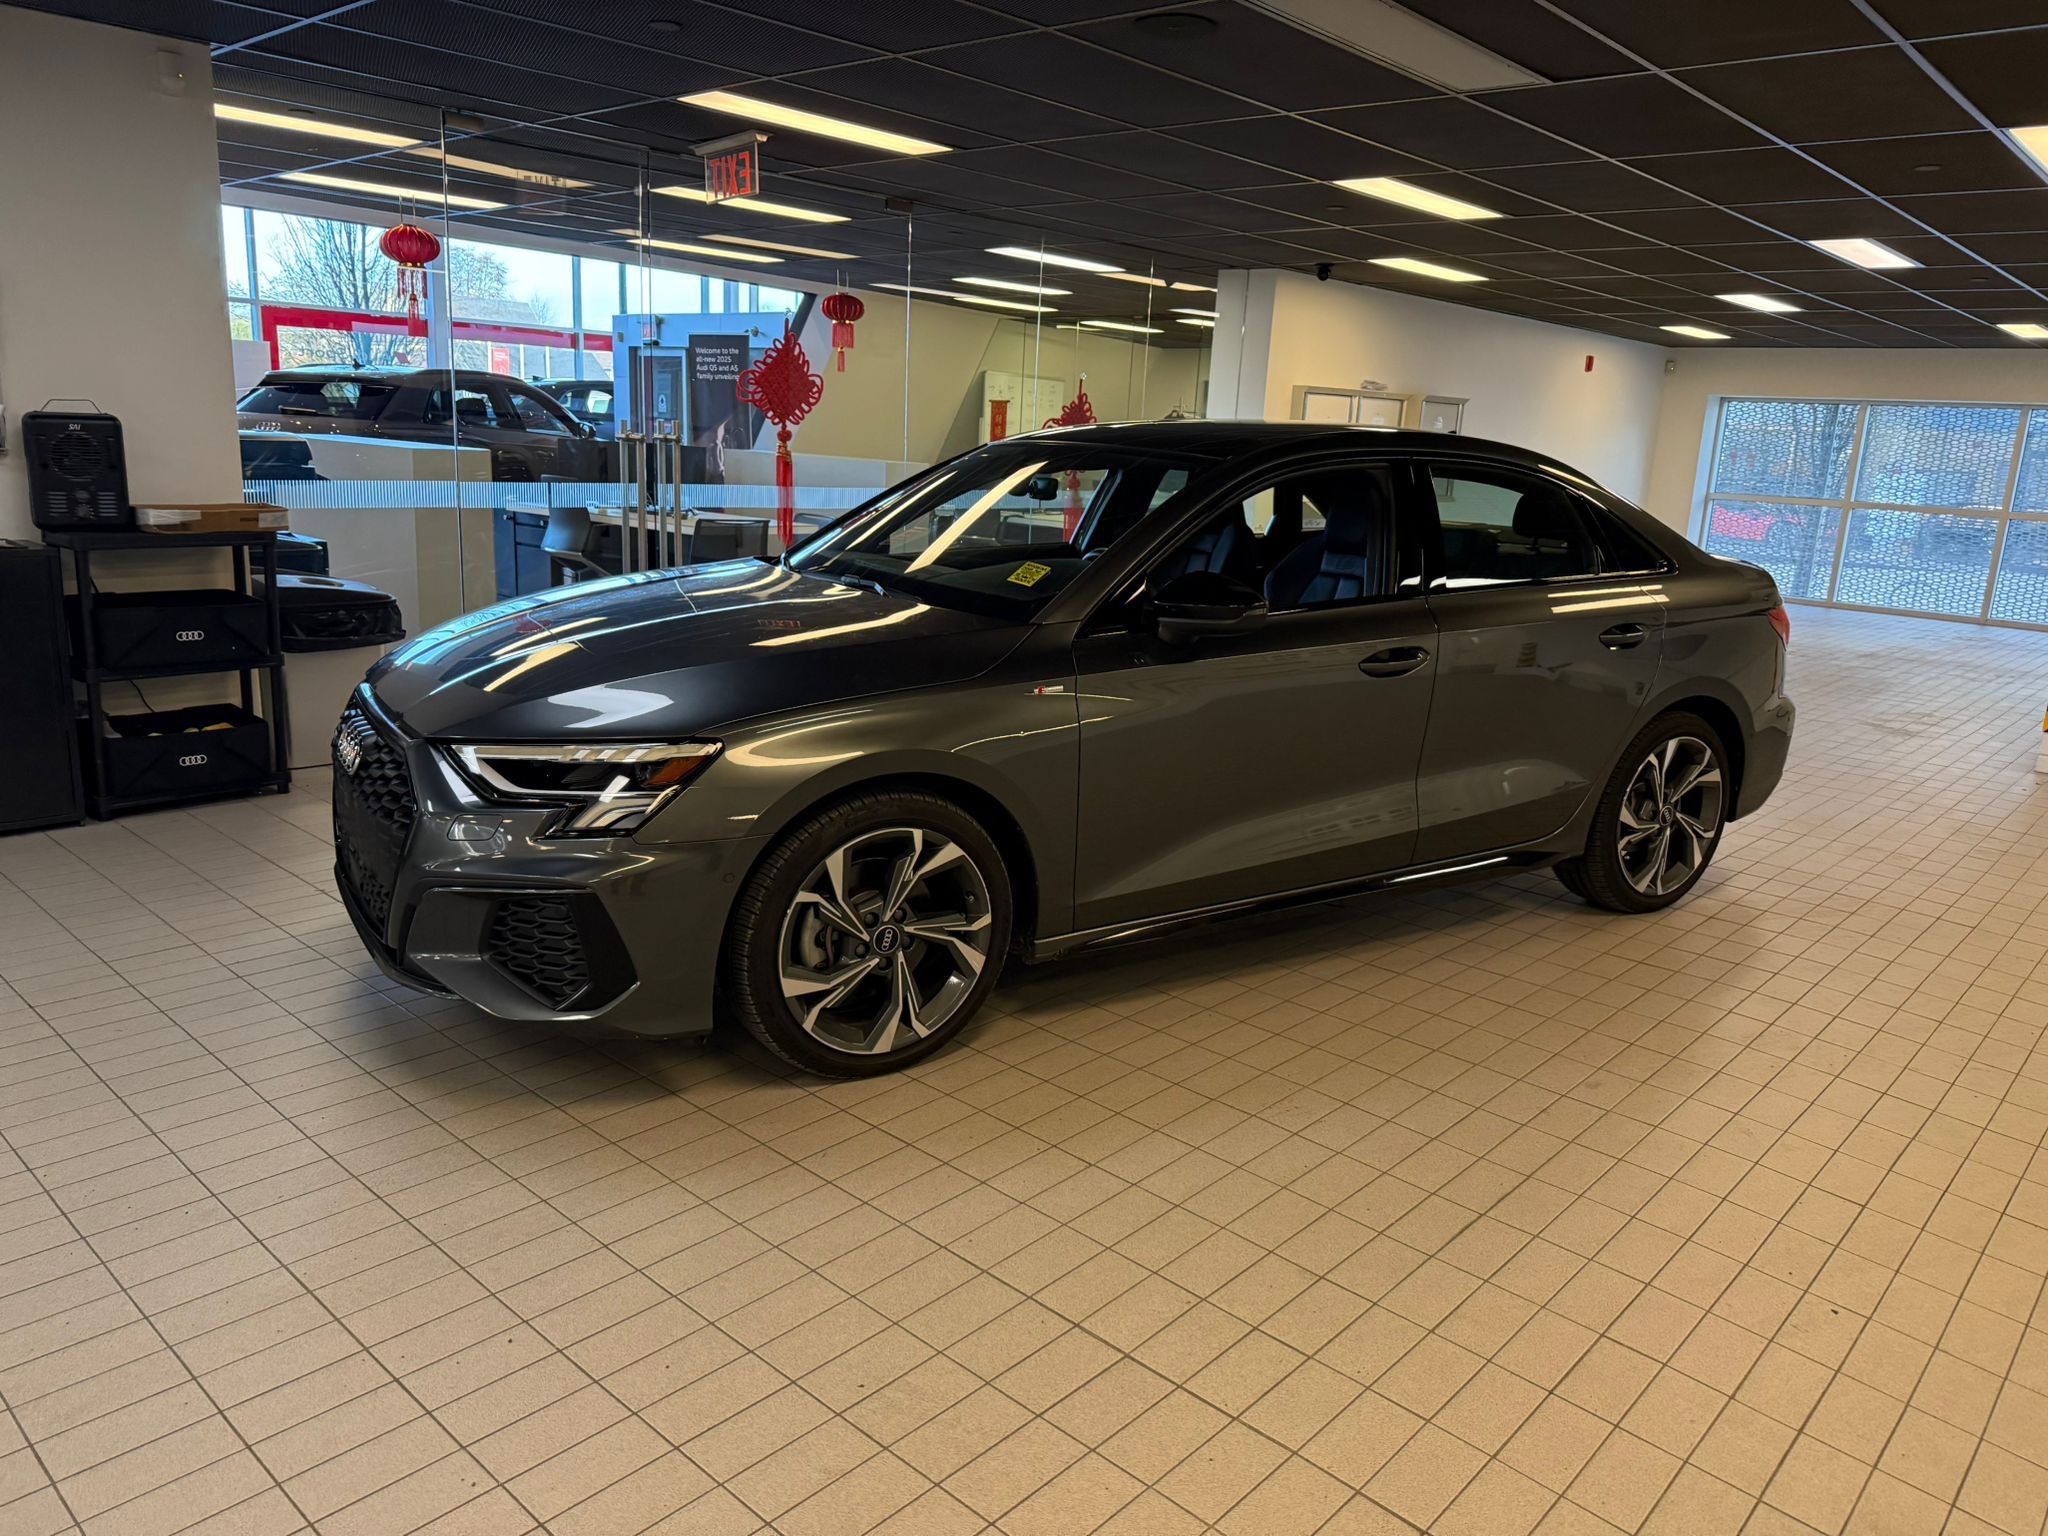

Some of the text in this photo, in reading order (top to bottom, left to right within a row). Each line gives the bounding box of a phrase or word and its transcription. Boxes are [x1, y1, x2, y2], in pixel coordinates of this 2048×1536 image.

[717, 355, 732, 363] 2025
[709, 364, 718, 372] Q5
[730, 364, 739, 372] A5
[697, 372, 713, 381] family
